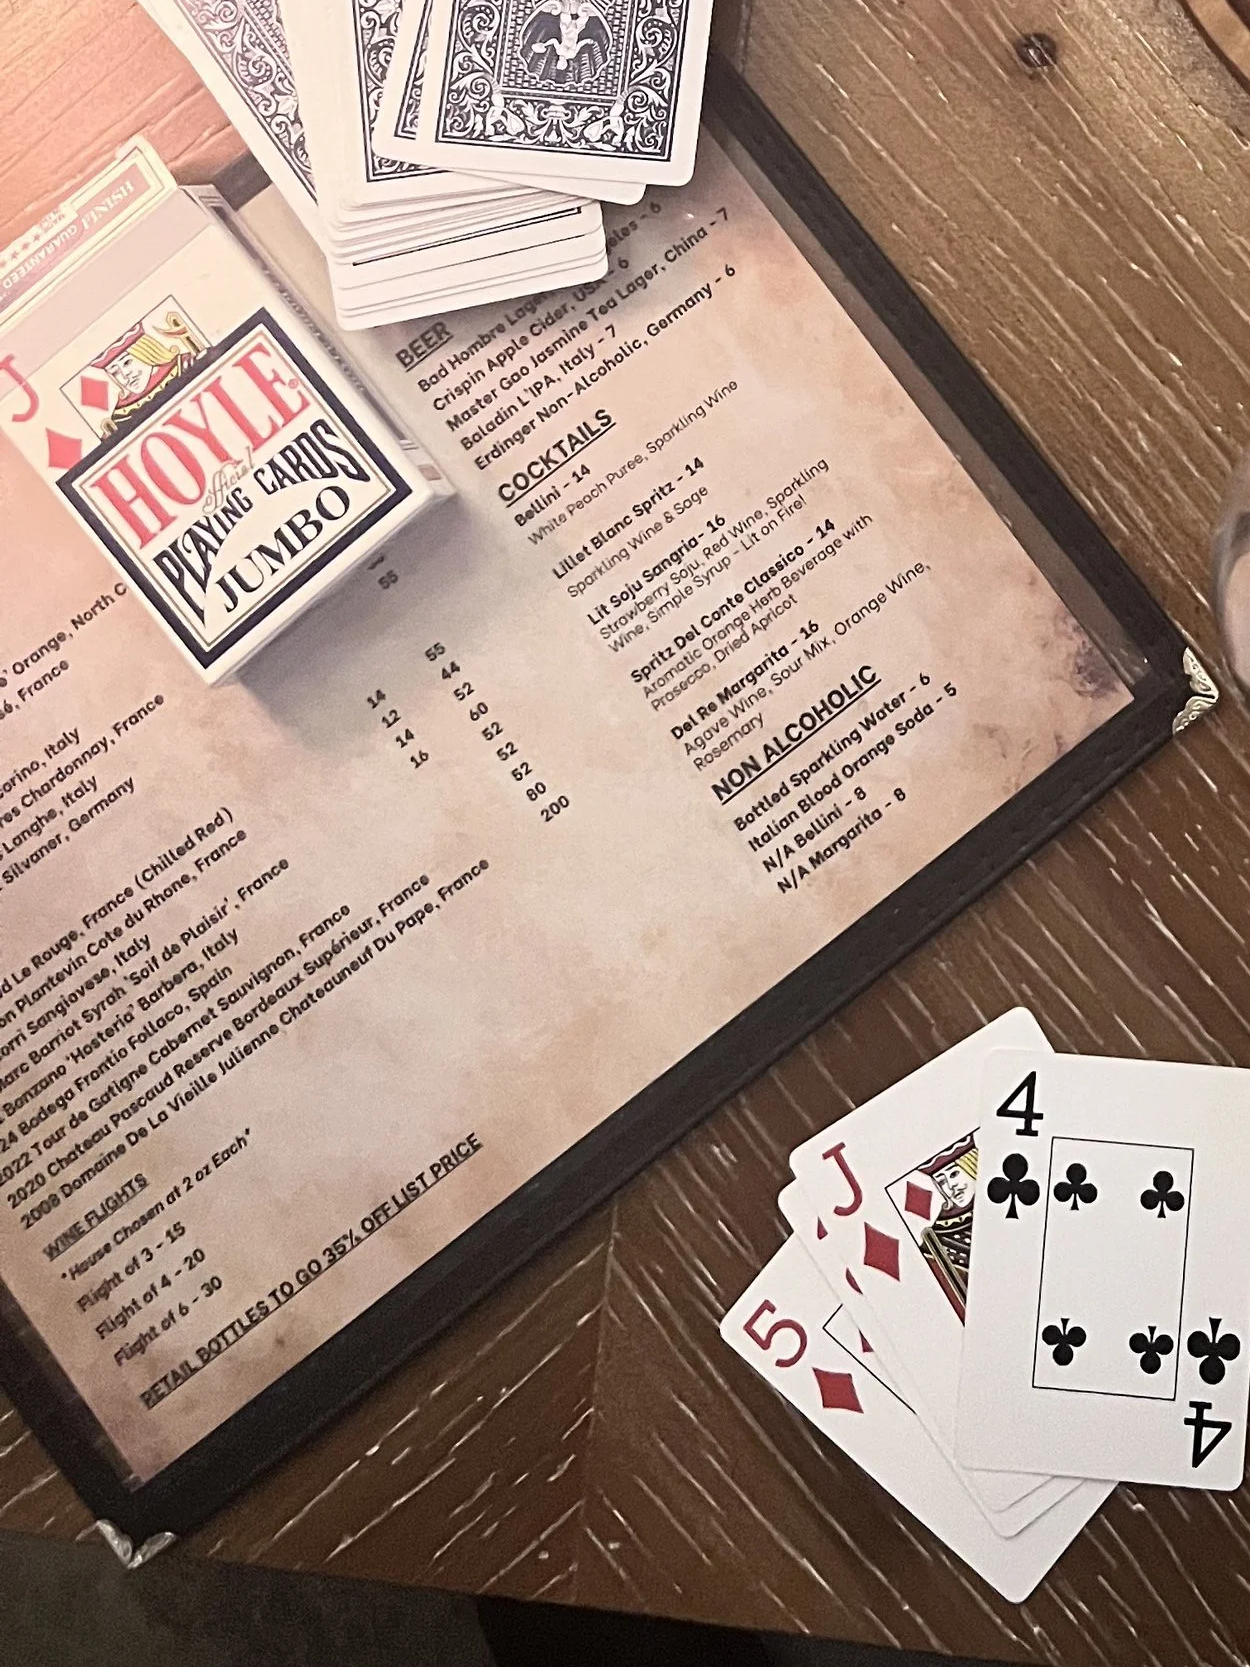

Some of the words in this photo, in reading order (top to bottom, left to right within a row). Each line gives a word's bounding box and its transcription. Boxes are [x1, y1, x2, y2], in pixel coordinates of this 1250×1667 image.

[394, 321, 453, 369] BEER
[416, 362, 450, 393] Bad
[450, 326, 507, 371] Hombre
[432, 369, 486, 411] Crispin
[486, 335, 530, 373] Apple
[529, 303, 576, 337] Cider,
[616, 257, 630, 270] 6
[445, 388, 498, 433] Master
[499, 365, 530, 391] Gao
[529, 320, 589, 369] Jasmine
[585, 296, 619, 322] Tea
[615, 263, 667, 301] Lager,
[663, 226, 709, 263] China
[715, 206, 729, 222] 7
[473, 418, 537, 471] Erdinger
[535, 338, 649, 423] Non-Alcoholic,
[646, 282, 713, 337] Germany
[724, 263, 736, 278] 6
[0, 353, 42, 423] J
[459, 404, 520, 451] Baladin
[558, 342, 596, 375] Italy
[604, 323, 616, 339] 7
[497, 408, 612, 502] COCKTAILS
[513, 485, 562, 527] Bellini
[571, 463, 591, 484] 14
[527, 513, 568, 546] White
[565, 482, 608, 517] Peach
[605, 454, 649, 486] Puree,
[645, 405, 707, 454] Sparkling
[703, 380, 738, 409] Wine
[153, 483, 253, 625] PLAYING
[252, 418, 371, 495] CARDS
[216, 486, 352, 613] JUMBO
[551, 544, 593, 580] Lillet
[589, 514, 633, 551] Blanc
[631, 481, 676, 518] Spritz
[684, 456, 705, 477] 14
[566, 547, 631, 598] Sparkling
[626, 521, 664, 551] Wine
[662, 510, 676, 524] &
[673, 486, 709, 516] Sage
[599, 581, 670, 640] Strawberry
[669, 559, 705, 585] Soju,
[702, 533, 730, 560] Red
[727, 509, 769, 539] Wine,
[765, 458, 830, 510] Sparkling
[586, 603, 611, 626] Lit
[609, 579, 644, 609] Soju
[705, 514, 726, 534] 16
[607, 624, 650, 653] Wine,
[646, 585, 694, 624] Simple
[692, 556, 732, 589] Syrup
[739, 532, 761, 552] Lit
[760, 519, 779, 536] on
[630, 646, 676, 684] Spritz
[672, 623, 702, 651] Del
[699, 593, 745, 629] Conte
[743, 545, 805, 595] Classico
[815, 518, 836, 540] 14
[11, 631, 74, 676] Orange,
[70, 594, 116, 631] North
[424, 641, 446, 662] 55
[441, 660, 461, 681] 44
[669, 713, 699, 741] Del
[715, 644, 790, 705] Margarita
[799, 619, 820, 640] 16
[683, 716, 730, 757] Agave
[727, 687, 774, 719] Wine,
[770, 656, 804, 687] Sour
[802, 636, 837, 661] Mix,
[834, 592, 888, 636] Orange
[884, 562, 932, 595] Wine,
[366, 688, 387, 710] 14
[381, 708, 402, 729] 12
[395, 728, 415, 749] 14
[452, 681, 475, 702] 52
[469, 701, 489, 722] 60
[480, 721, 504, 742] 52
[692, 712, 764, 772] Rosemary
[710, 754, 762, 802] NON
[762, 665, 877, 764] ALCOHOLIC
[20, 736, 116, 808] Chardonnay,
[111, 694, 165, 738] France
[409, 749, 430, 770] 16
[495, 741, 519, 762] 52
[510, 761, 534, 782] 52
[525, 781, 547, 802] 80
[732, 780, 791, 832] Bottled
[789, 728, 863, 788] Sparkling
[857, 691, 907, 732] Water
[918, 672, 931, 687] 6
[747, 810, 800, 853] Italian
[796, 772, 843, 814] Blood
[841, 734, 896, 779] Orange
[894, 703, 935, 737] Soda
[943, 681, 957, 698] 5
[1, 832, 70, 885] Silvaner,
[68, 776, 135, 833] Germany
[540, 794, 570, 823] 200
[761, 844, 796, 874] N/A
[793, 802, 844, 849] Bellini
[853, 785, 867, 801] 8
[776, 864, 811, 895] N/A
[808, 808, 884, 870] Margarita
[892, 787, 907, 802] 8
[10, 966, 32, 985] Le
[30, 930, 86, 970] Rouge,
[81, 886, 135, 930] France
[14, 954, 88, 1014] Plantevin
[86, 926, 124, 957] Cote
[124, 908, 145, 929] du
[142, 873, 198, 914] Rhone,
[193, 829, 247, 874] France
[231, 972, 305, 1032] Bordeaux
[377, 874, 430, 918] France
[279, 945, 374, 1026] Chateauneuf
[372, 930, 397, 953] Du
[394, 902, 441, 936] Pape,
[436, 859, 490, 902] France
[148, 1007, 219, 1066] Cabernet
[216, 947, 302, 1012] Sauvignon,
[298, 904, 351, 949] France
[995, 1070, 1044, 1137] 4
[267, 1281, 298, 1307] TO
[295, 1258, 326, 1289] GO
[322, 1228, 363, 1267] 35%
[360, 1201, 398, 1234] OFF
[390, 1171, 434, 1211] LIST
[429, 1131, 484, 1182] PRICE
[821, 1141, 864, 1218] J
[742, 1298, 808, 1368] 5
[1183, 1400, 1233, 1469] 4
